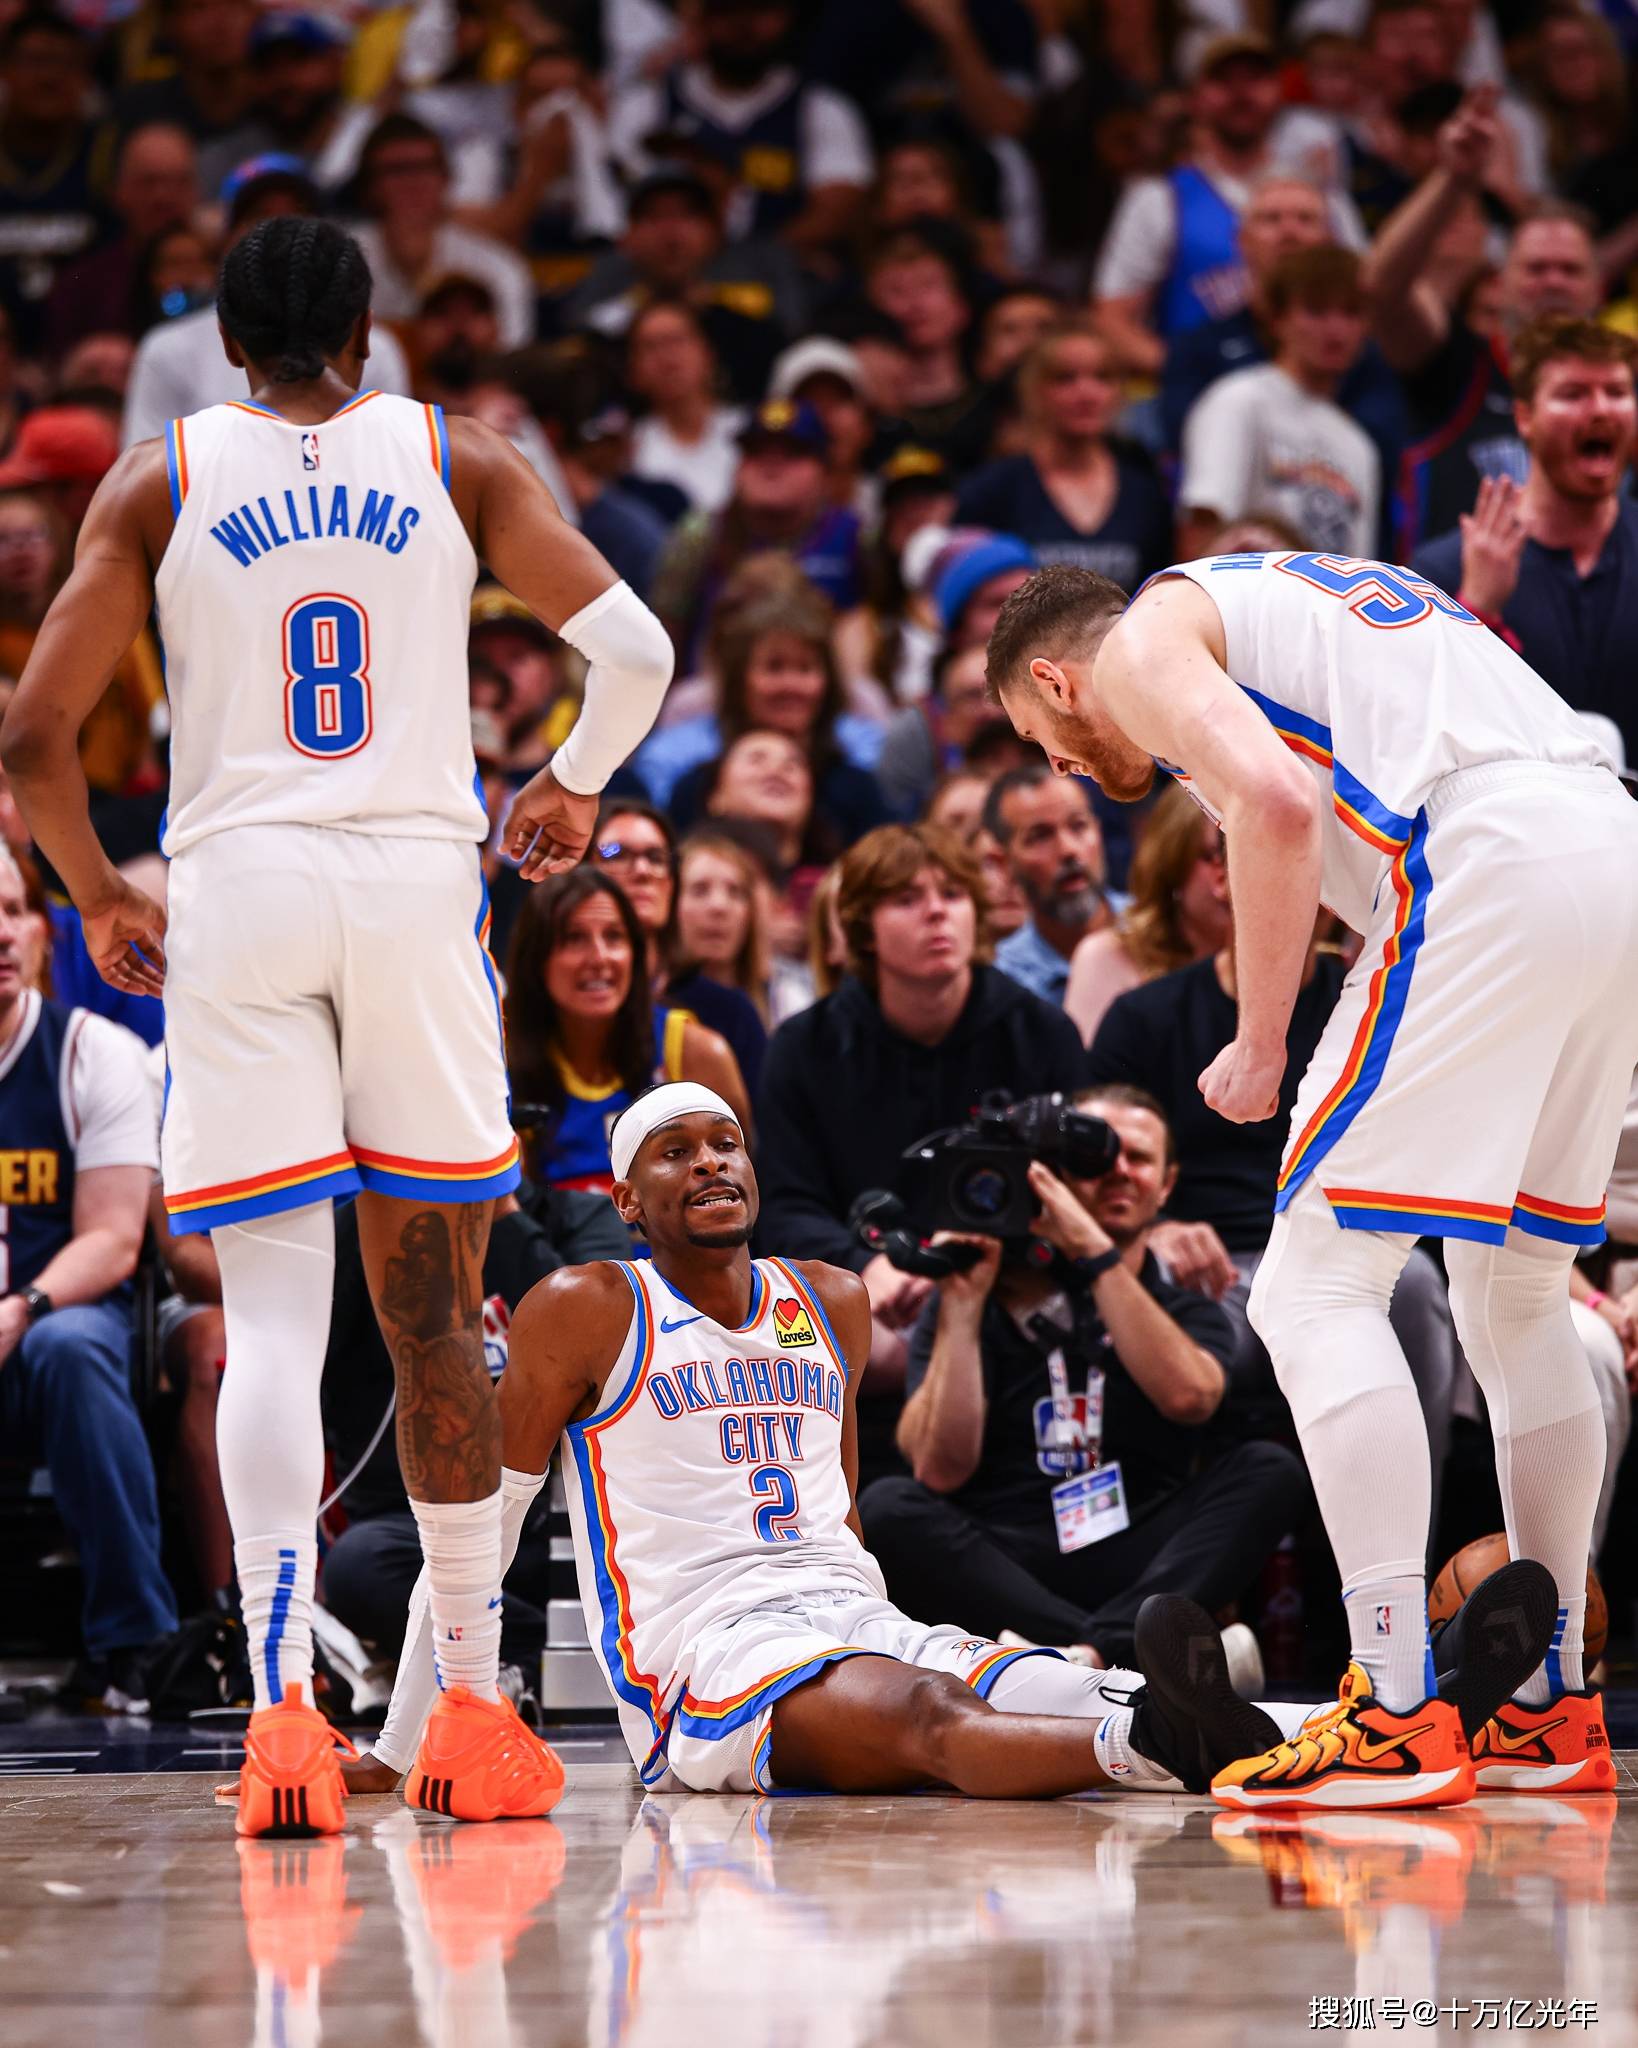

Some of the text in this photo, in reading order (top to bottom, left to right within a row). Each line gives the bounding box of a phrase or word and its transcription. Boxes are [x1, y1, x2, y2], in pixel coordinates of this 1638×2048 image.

[209, 485, 420, 568] WILLIAMS
[281, 591, 374, 762] 8
[647, 1357, 843, 1422] OKLAHOMA
[719, 1412, 804, 1464] CITY
[749, 1463, 808, 1543] 2
